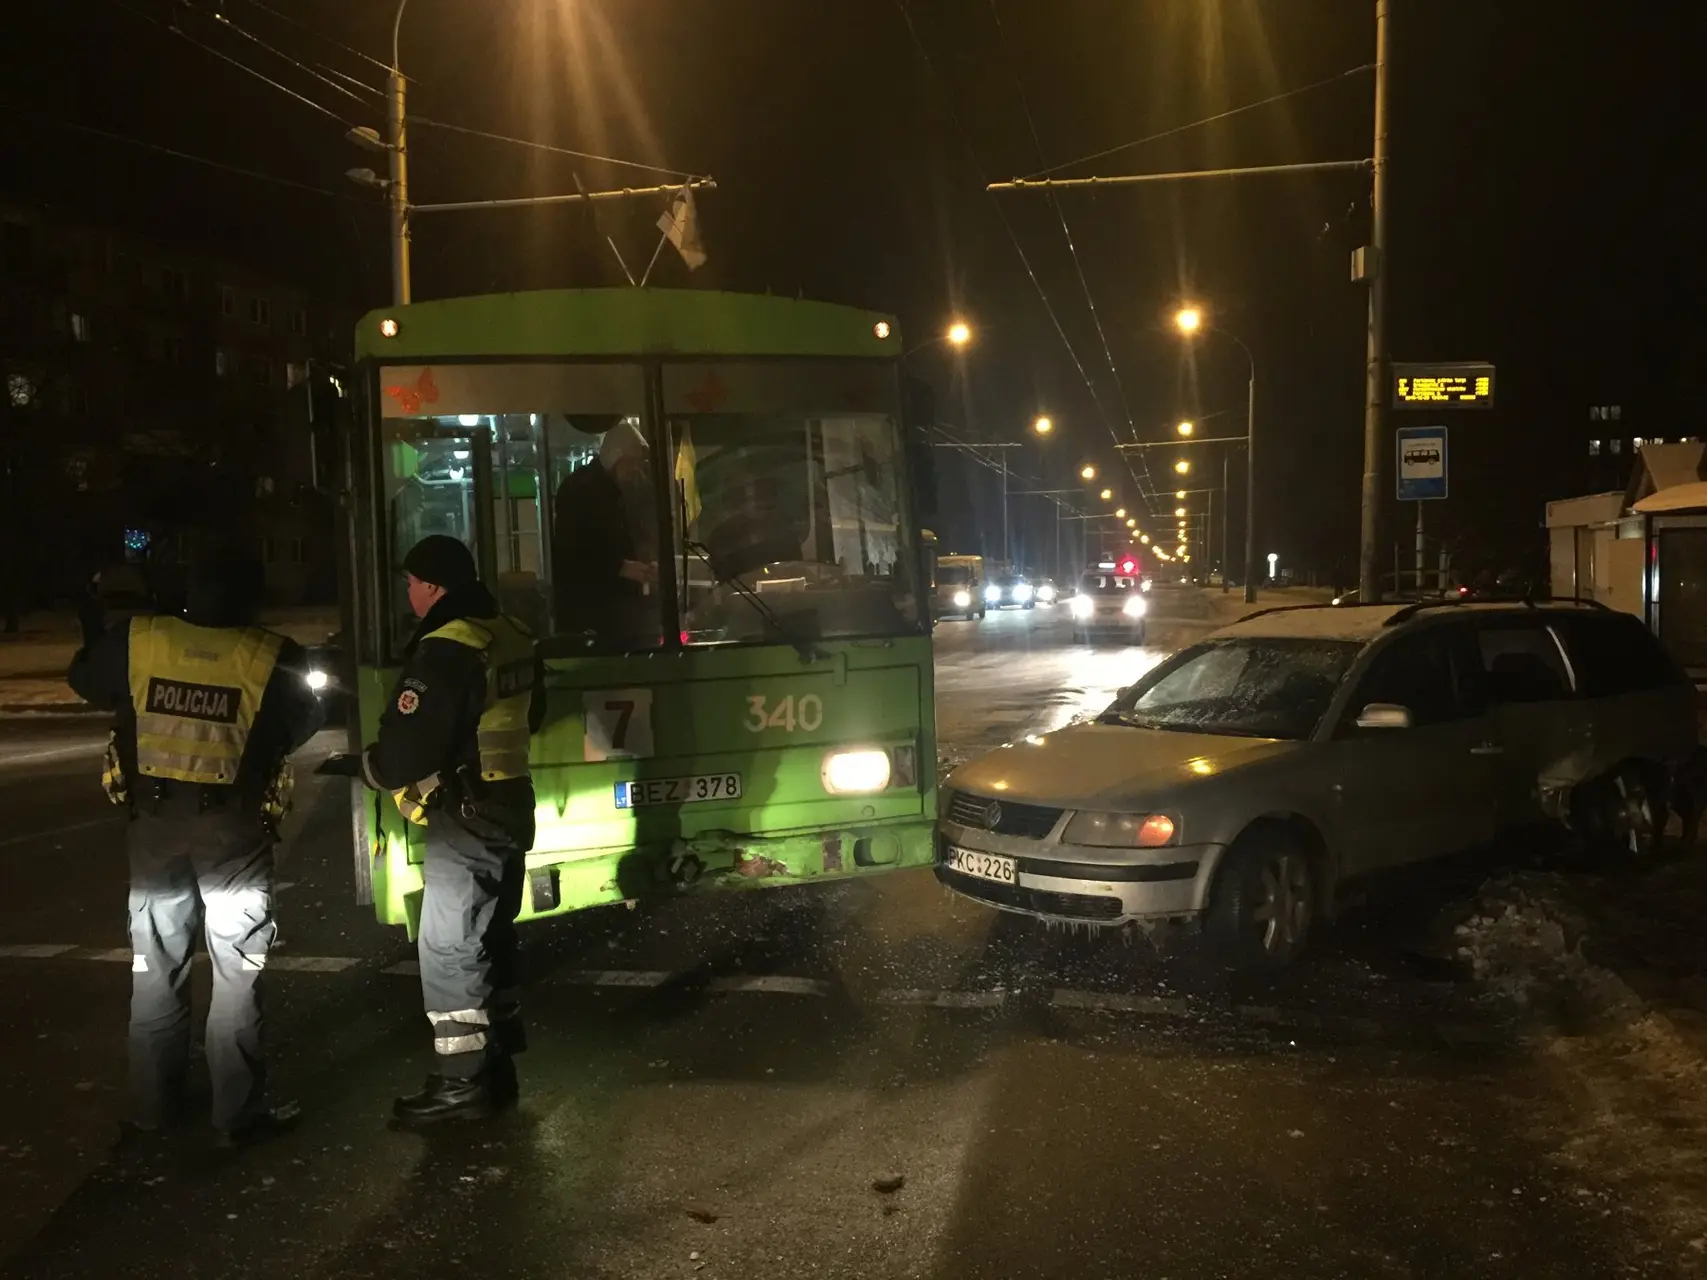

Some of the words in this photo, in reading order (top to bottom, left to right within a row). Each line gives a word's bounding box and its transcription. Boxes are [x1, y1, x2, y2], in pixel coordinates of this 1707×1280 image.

[153, 683, 229, 718] POLICIJA
[743, 693, 823, 732] 340
[604, 700, 635, 750] 7
[630, 781, 680, 804] BEZ
[696, 775, 738, 798] 378
[983, 857, 1012, 881] 226
